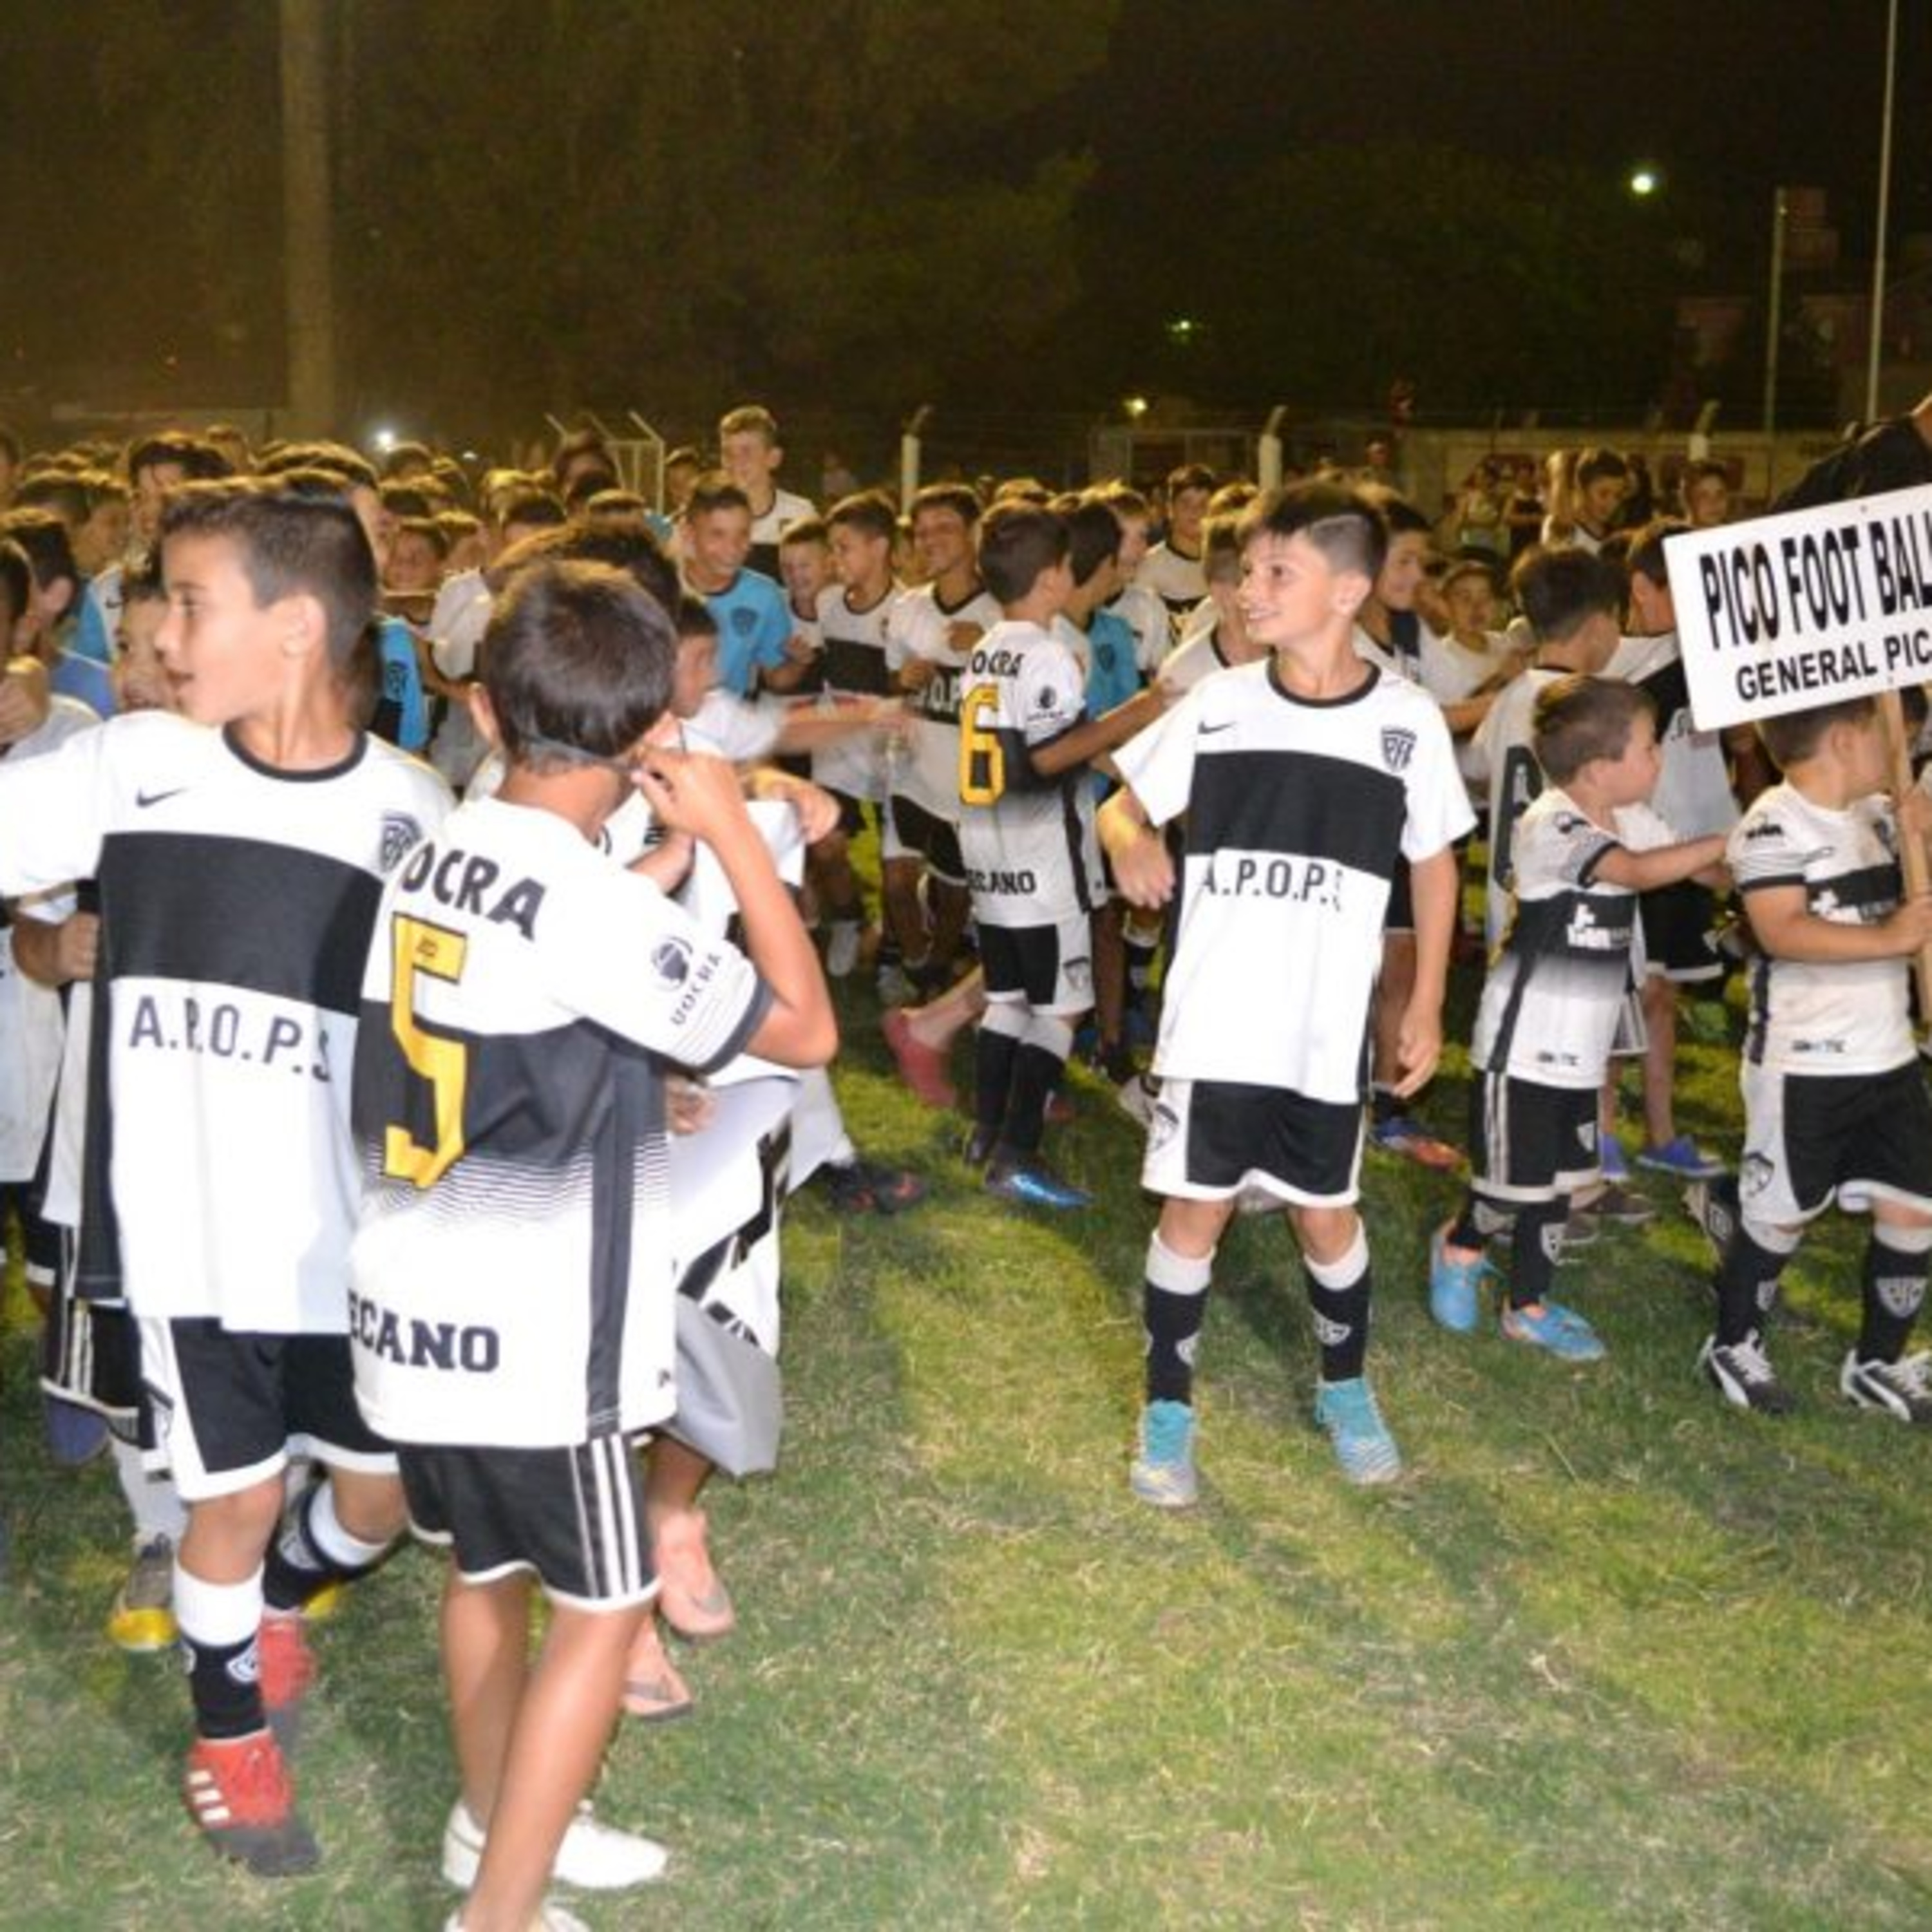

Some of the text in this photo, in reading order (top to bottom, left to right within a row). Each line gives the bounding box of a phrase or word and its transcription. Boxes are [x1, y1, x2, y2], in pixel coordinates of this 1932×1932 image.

[1700, 543, 1779, 650] PICO
[1781, 525, 1865, 634] FOOT
[1736, 641, 1877, 701] GENERAL
[959, 681, 1005, 806] 6
[386, 911, 468, 1189] 5
